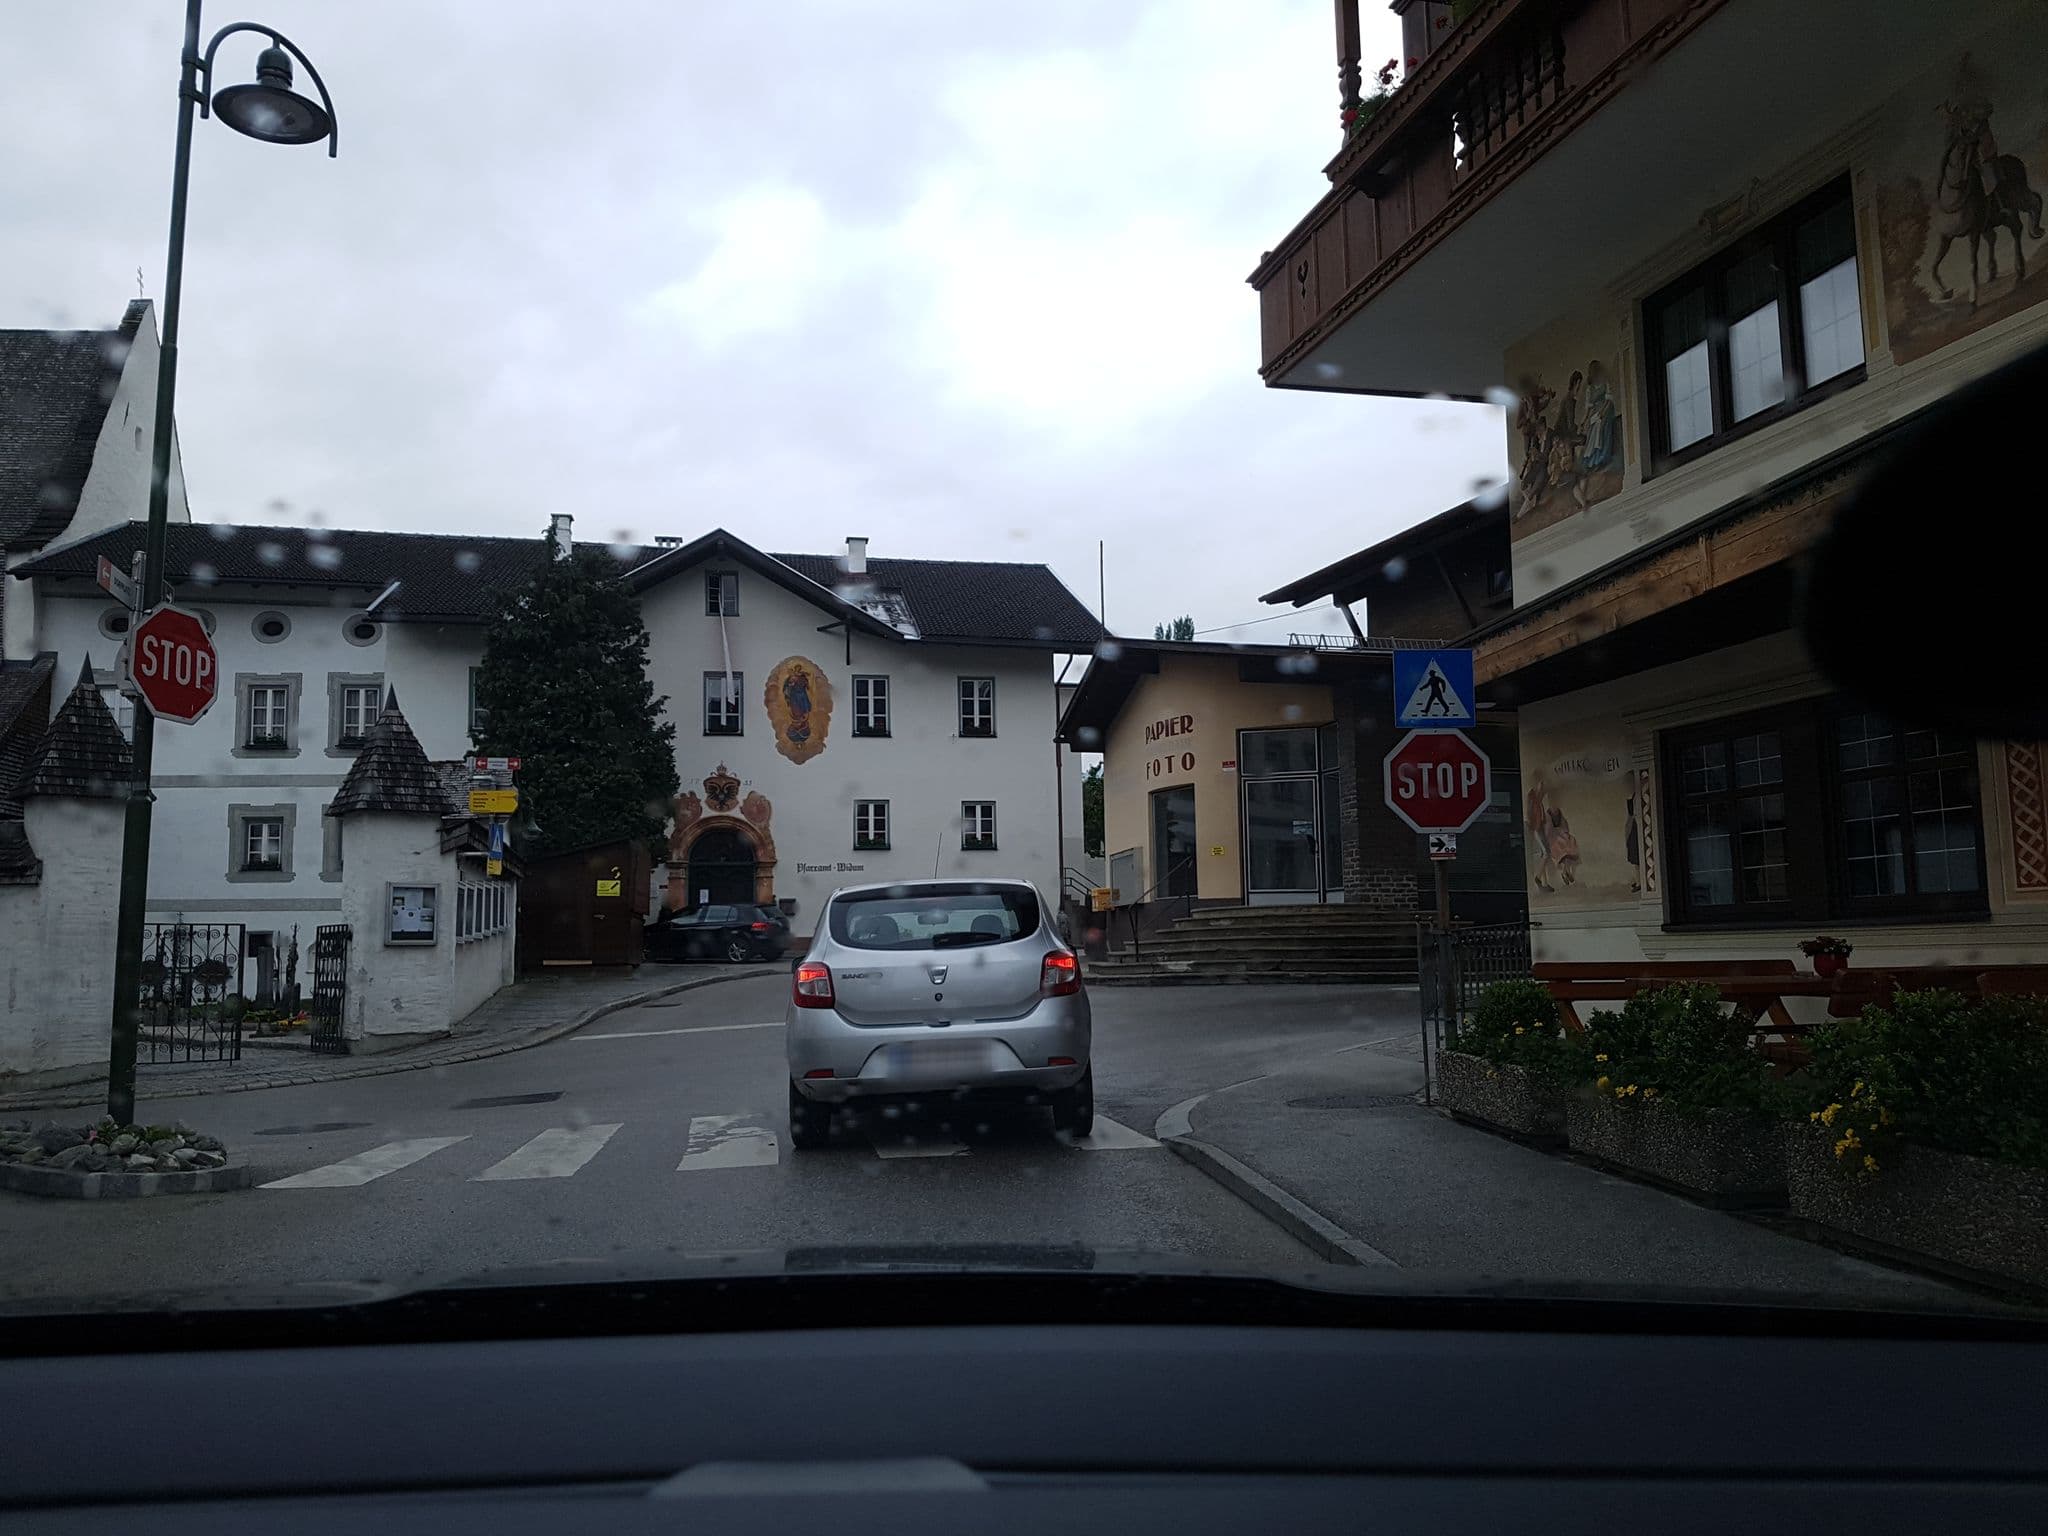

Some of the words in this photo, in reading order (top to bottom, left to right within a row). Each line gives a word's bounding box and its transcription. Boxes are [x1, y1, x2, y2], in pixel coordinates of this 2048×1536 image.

[141, 635, 211, 688] STOP
[1145, 714, 1194, 744] PAPIER
[1146, 752, 1195, 780] FOTO
[1398, 762, 1478, 799] STOP
